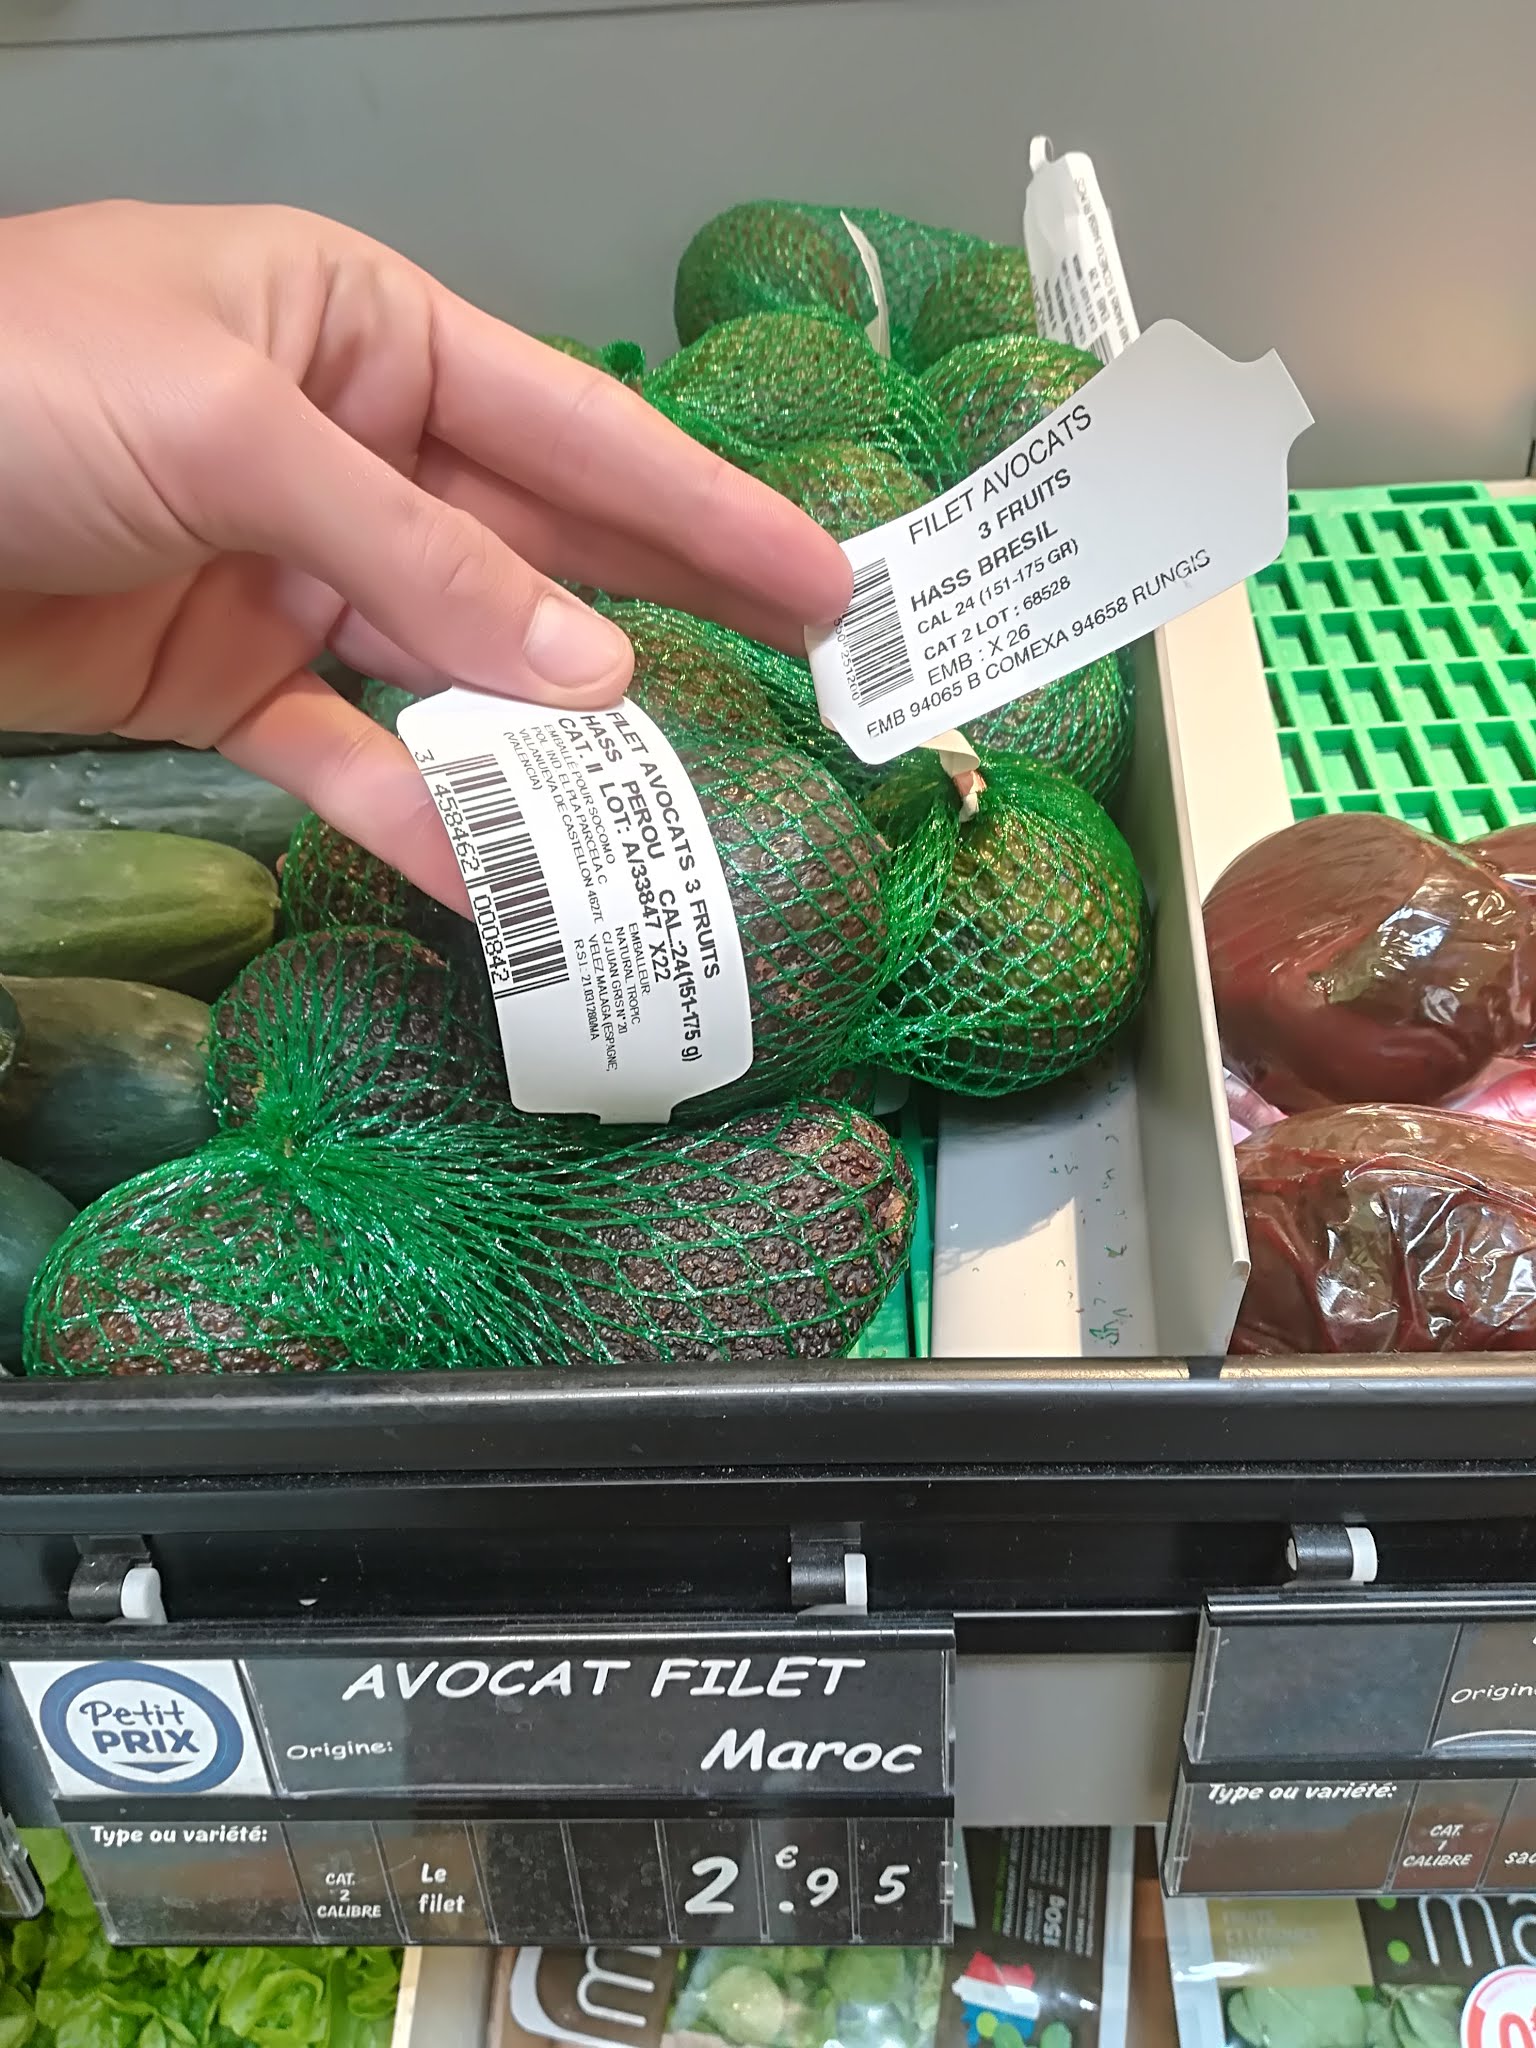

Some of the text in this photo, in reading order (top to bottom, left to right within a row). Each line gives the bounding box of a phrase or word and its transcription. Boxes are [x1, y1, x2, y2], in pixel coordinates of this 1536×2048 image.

[909, 404, 1092, 545] FILET AVOCATS
[978, 468, 1072, 539] 3 FRUITS
[910, 520, 1059, 612] HASS BRESIL
[917, 538, 1079, 634] CAL 24 (151-175 GR)
[866, 548, 1211, 739] EMB 94065 B COMEXA 94658 RUNGIS
[924, 635, 958, 661] CAT
[961, 628, 973, 643] 2
[975, 607, 1010, 636] LOT
[1022, 575, 1072, 610] 68528
[927, 652, 973, 686] EMB
[987, 635, 1004, 656] X
[1005, 623, 1031, 647] 26
[502, 731, 543, 792] (VALENCIA)
[518, 728, 559, 793] VILLANUEVA
[580, 715, 623, 763] HASS
[621, 780, 666, 860] PEROU
[553, 794, 570, 814] DE
[558, 773, 571, 790] EL
[566, 790, 582, 813] PLA
[576, 814, 605, 874] PARCELA
[571, 771, 595, 806] POUR
[588, 807, 616, 865] SOCOMO
[414, 749, 510, 984] 3 458462 000842
[558, 717, 672, 983] CAT. II LOT: A/33847 X22
[561, 814, 594, 888] CASTELLON
[605, 712, 721, 979] FILET AVOCATS 3 FRUITS
[588, 933, 604, 972] VELEZ
[596, 975, 611, 1022] MALAGA
[604, 947, 619, 979] JUAN
[615, 926, 641, 1025] NATURAL TROPIC
[611, 980, 625, 1009] GRIS
[341, 1656, 866, 1700] AVOCAT FILET
[1451, 1681, 1536, 1706] Origin
[79, 1699, 185, 1727] Petit
[92, 1729, 200, 1754] PRIX
[286, 1741, 393, 1760] Origine:
[700, 1728, 923, 1774] Maroc
[1208, 1781, 1398, 1805] Type ou variété:
[90, 1824, 268, 1847] Type ou variété:
[1402, 1853, 1473, 1868] CALIBRE
[325, 1872, 356, 1885] CAT.
[339, 1889, 351, 1901] 2
[418, 1893, 465, 1915] filet
[421, 1863, 447, 1884] Le
[316, 1904, 382, 1919] CALIBRE
